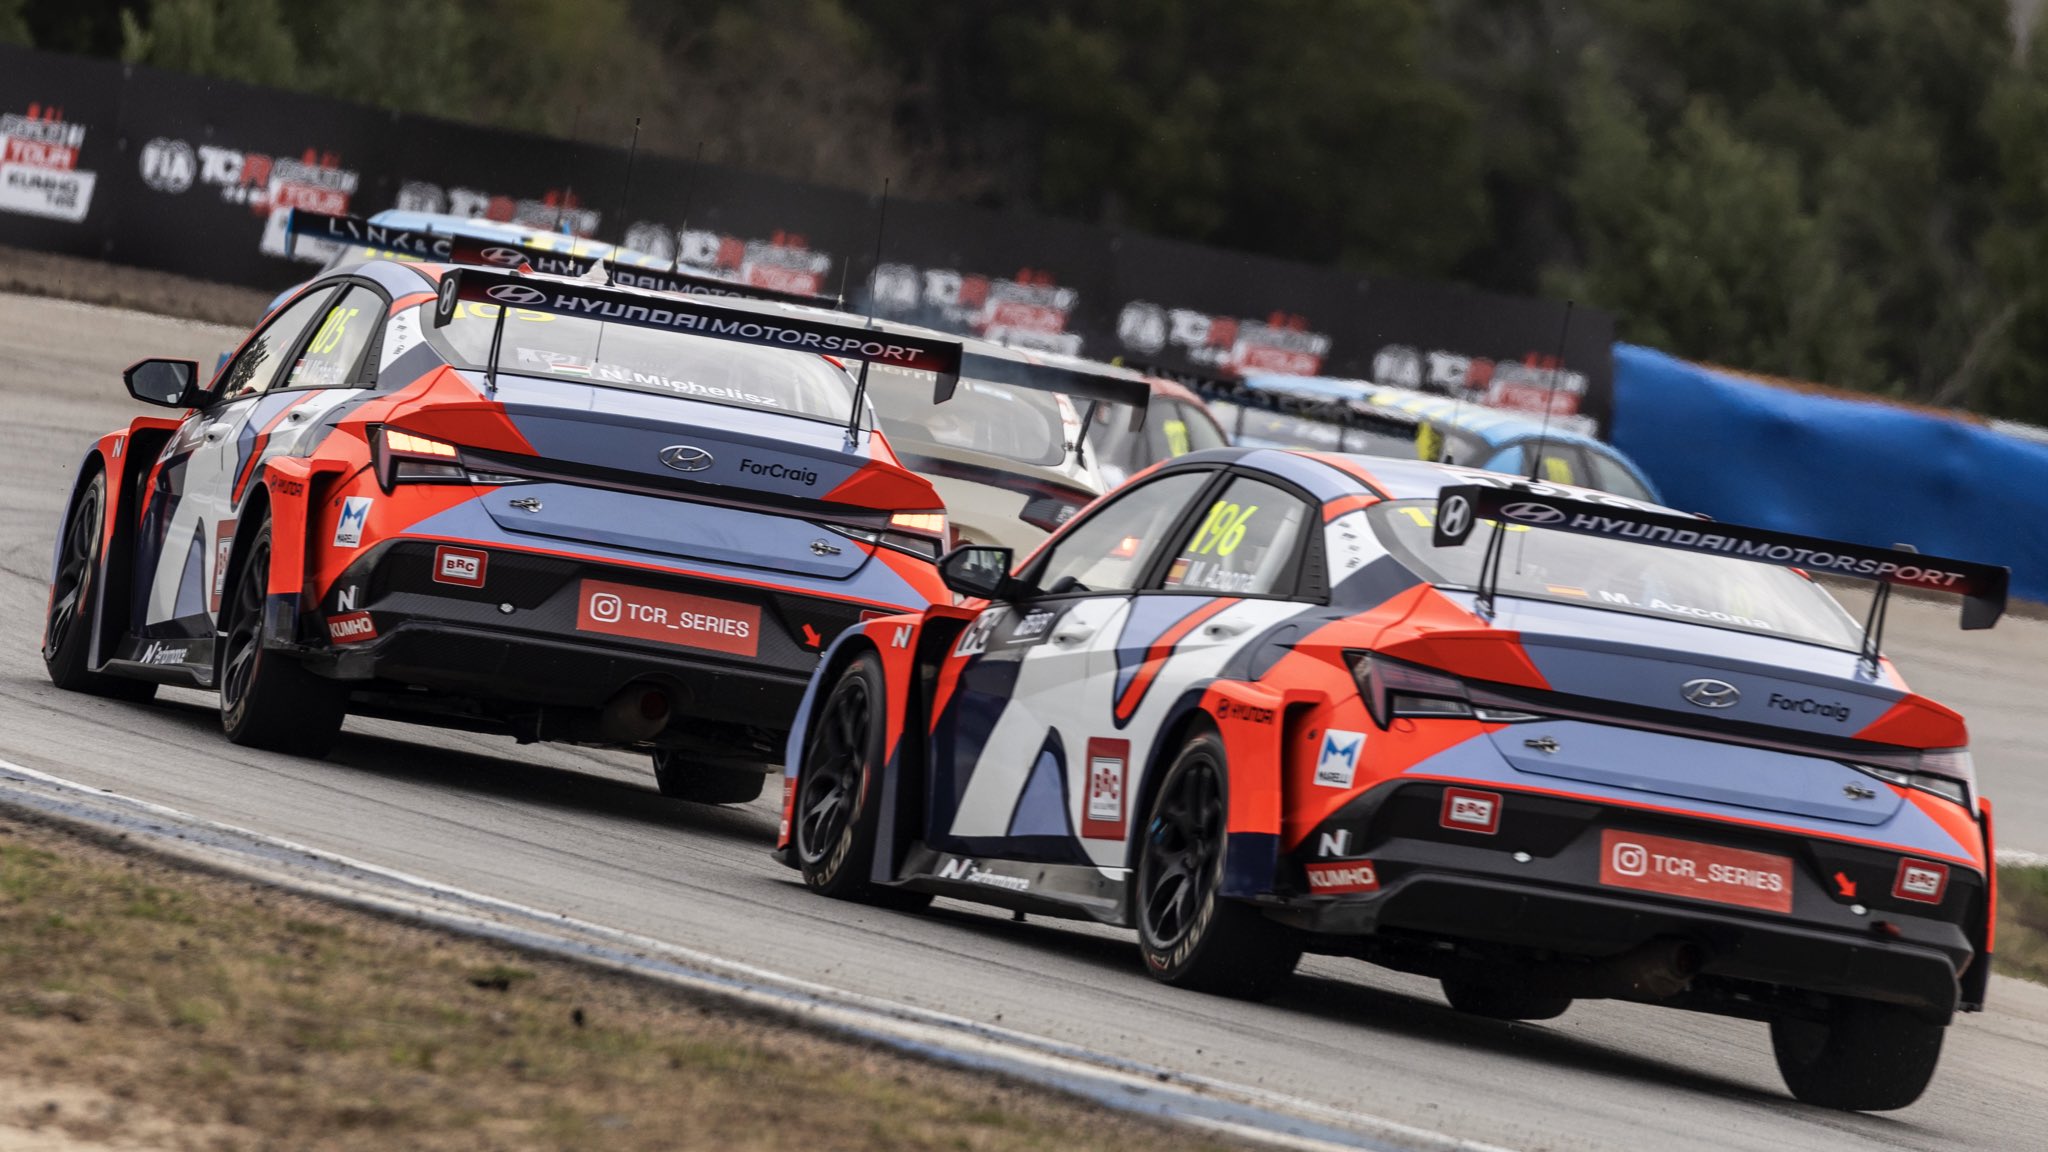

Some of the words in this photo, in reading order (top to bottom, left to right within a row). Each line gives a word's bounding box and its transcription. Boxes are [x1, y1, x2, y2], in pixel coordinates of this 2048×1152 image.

[553, 294, 709, 330] HYUNDAI
[710, 318, 925, 361] MOTORSPORT
[739, 459, 818, 486] ForCraig
[1188, 500, 1257, 557] 196
[1568, 512, 1735, 552] HYUNDAI
[1734, 539, 1963, 587] MOTORSPORT
[446, 558, 475, 573] BRC
[329, 616, 373, 638] KUMHO
[627, 603, 750, 638] TCR_SERIES
[1649, 598, 1774, 631] Azcona
[1767, 693, 1851, 722] ForCraig
[1456, 801, 1487, 817] BRC
[1308, 866, 1376, 888] KUMHO
[1651, 853, 1783, 893] TCR_SERIES
